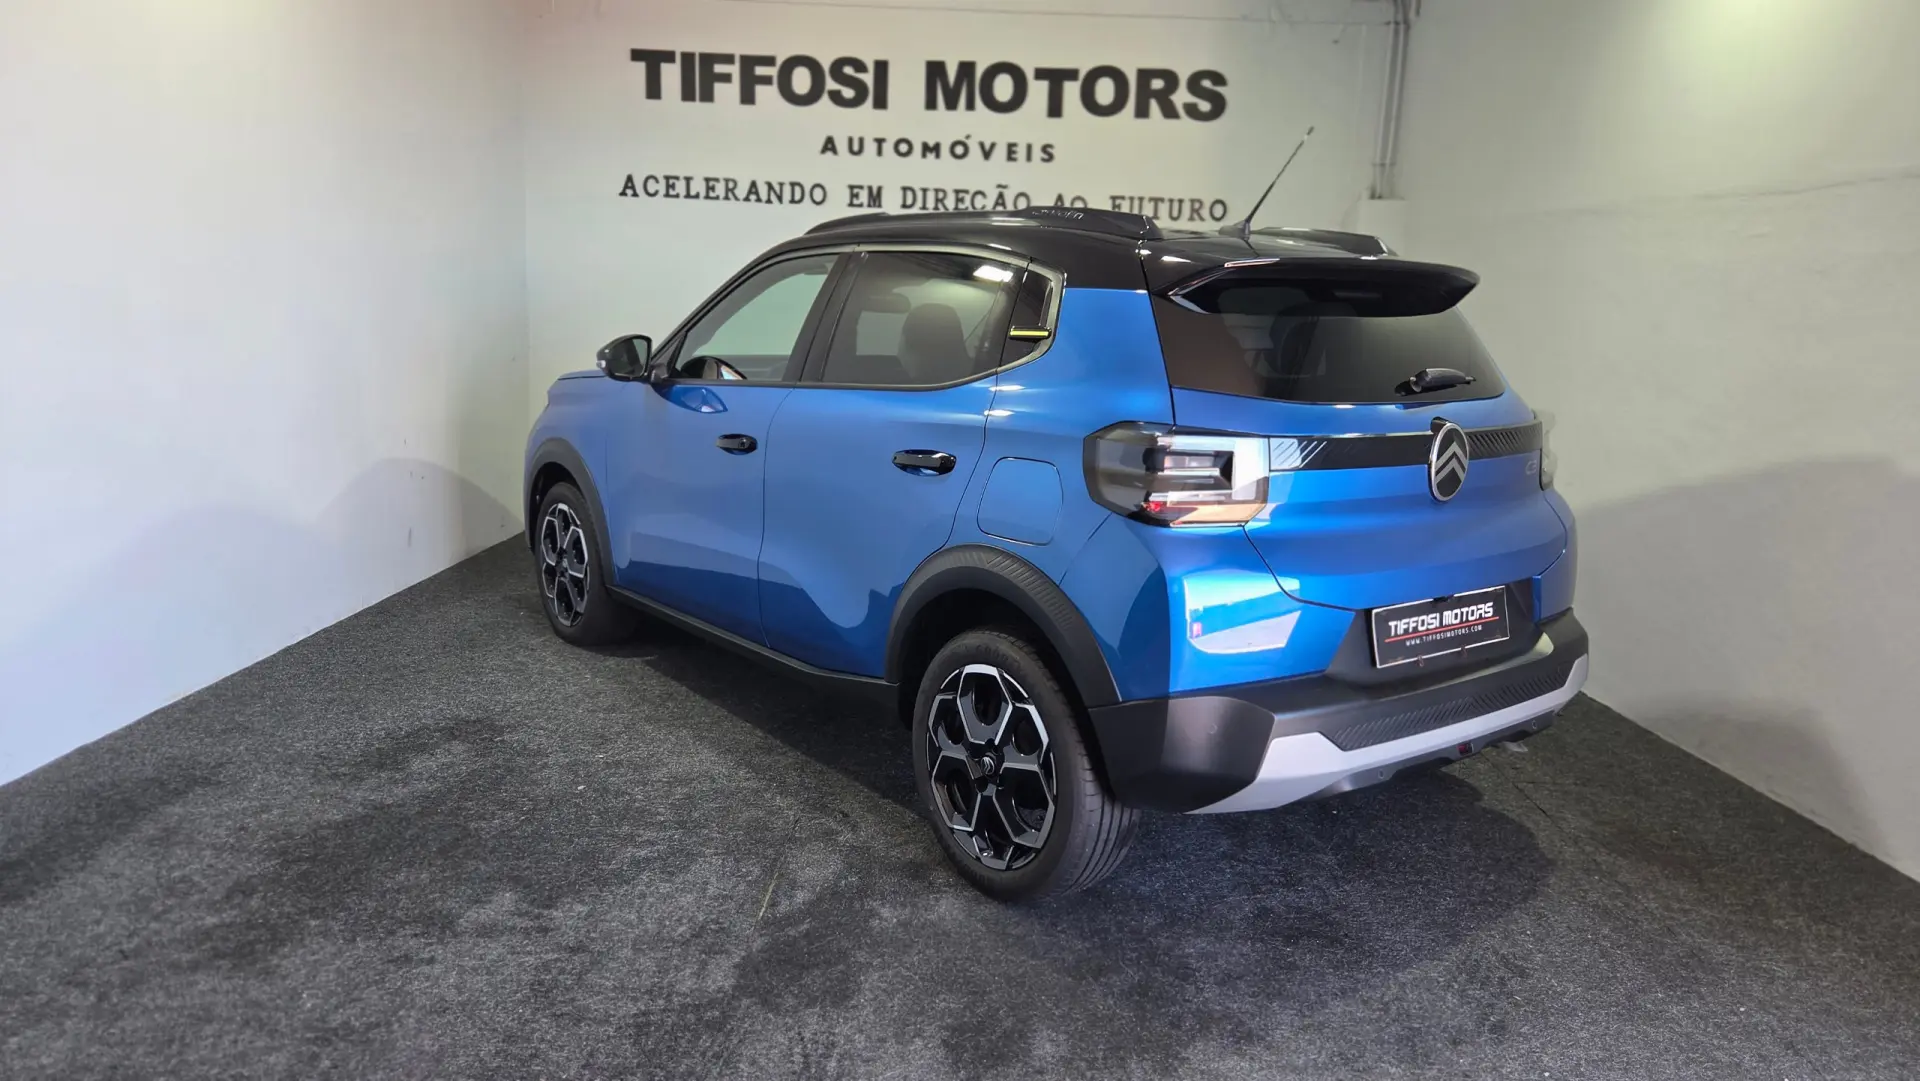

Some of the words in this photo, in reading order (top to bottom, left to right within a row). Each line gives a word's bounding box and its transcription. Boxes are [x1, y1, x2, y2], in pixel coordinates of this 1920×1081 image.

[630, 48, 890, 110] TIFFOSI
[924, 60, 1228, 122] MOTORS
[820, 134, 1056, 163] AUTOMÓVEIS
[618, 173, 828, 206] ACELERANDO
[847, 184, 883, 208] EM
[1109, 195, 1228, 222] FUTURO
[1388, 612, 1440, 637] TIFFOSI
[1442, 601, 1494, 627] MOTORS
